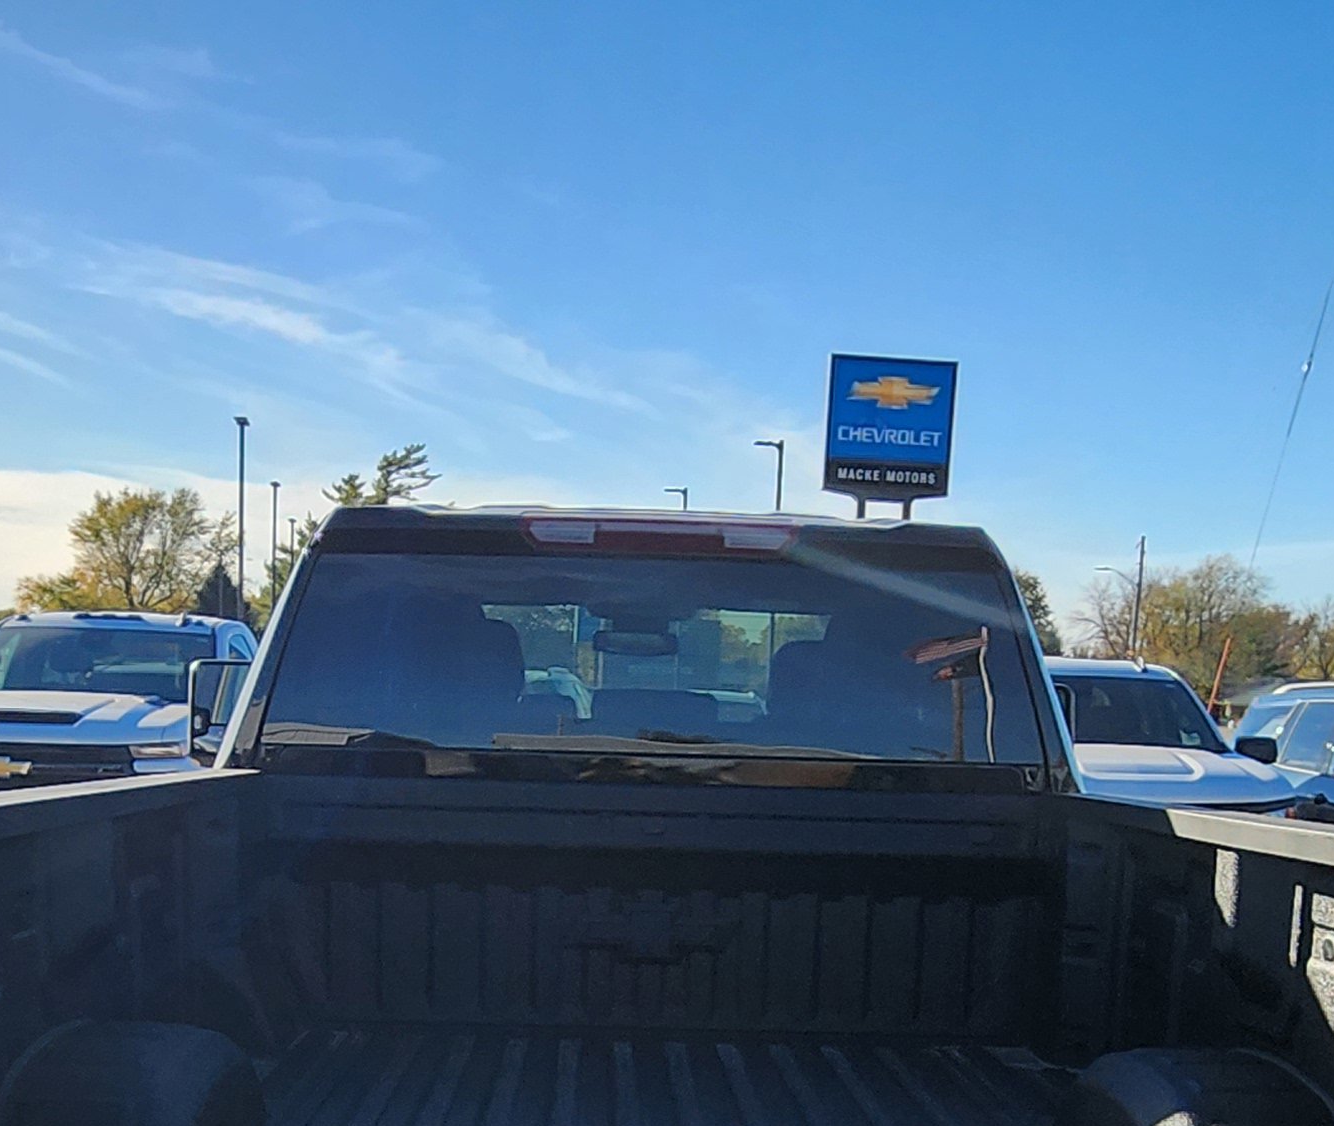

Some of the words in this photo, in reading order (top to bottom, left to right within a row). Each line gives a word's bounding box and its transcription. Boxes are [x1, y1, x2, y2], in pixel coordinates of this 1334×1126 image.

[837, 425, 942, 447] CHEVROLET
[837, 467, 880, 481] MACKE
[886, 470, 936, 485] MOTORS
